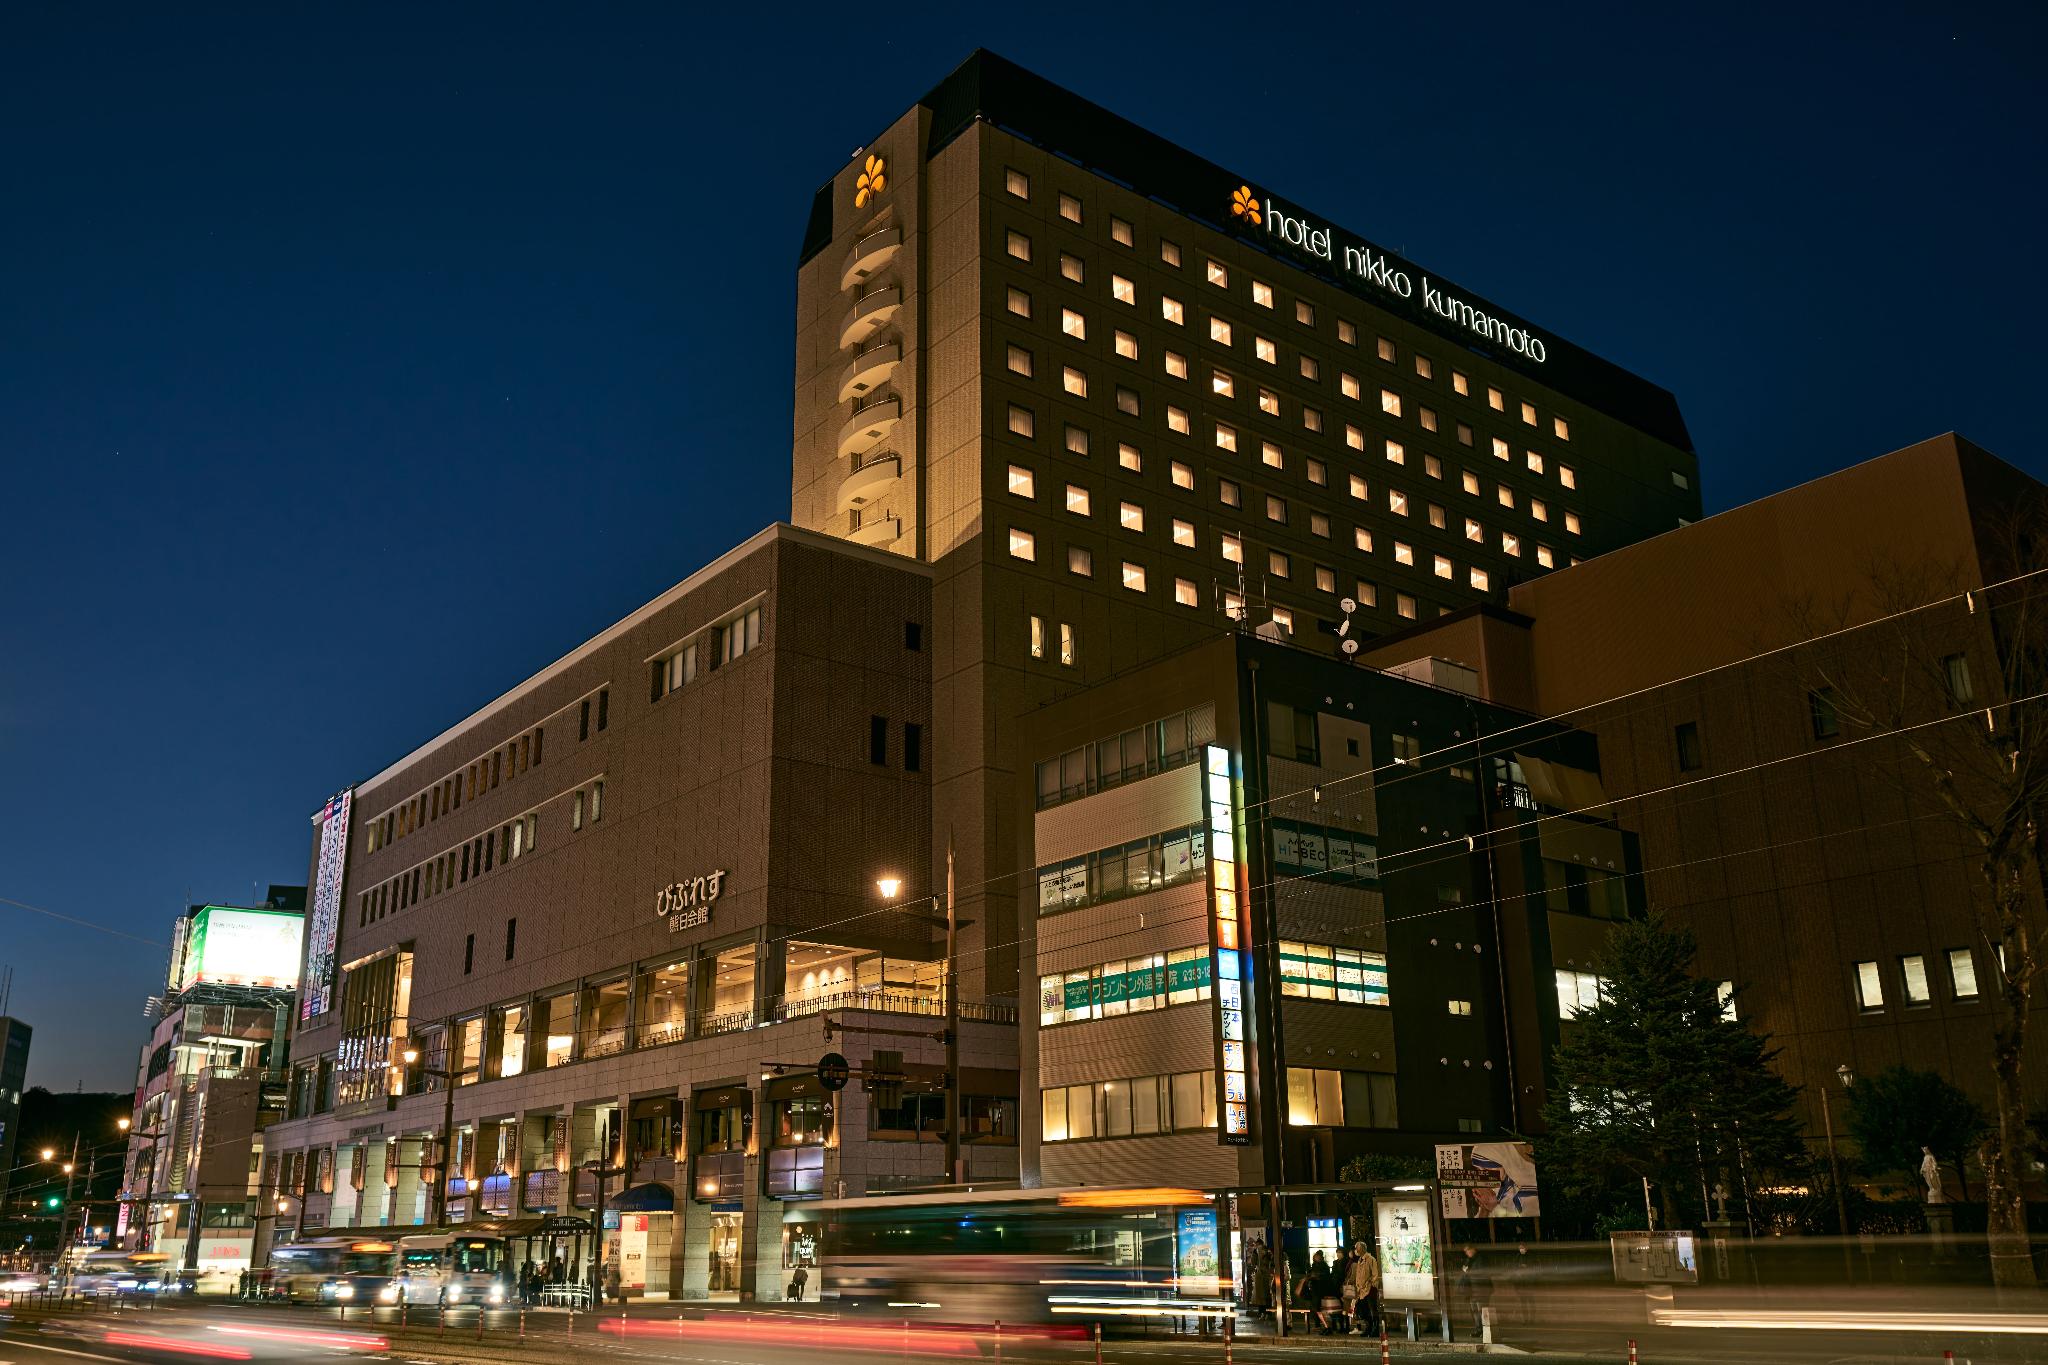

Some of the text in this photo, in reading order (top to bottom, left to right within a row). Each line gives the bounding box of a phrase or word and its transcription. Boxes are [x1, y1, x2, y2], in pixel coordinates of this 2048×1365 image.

[1265, 198, 1546, 363] hotel nikko kumamoto
[657, 869, 726, 916] びぷれす
[669, 906, 710, 933] 熊日会館
[1222, 999, 1231, 1039] チケット
[120, 1203, 129, 1224] JINS
[209, 1244, 240, 1257] JINS
